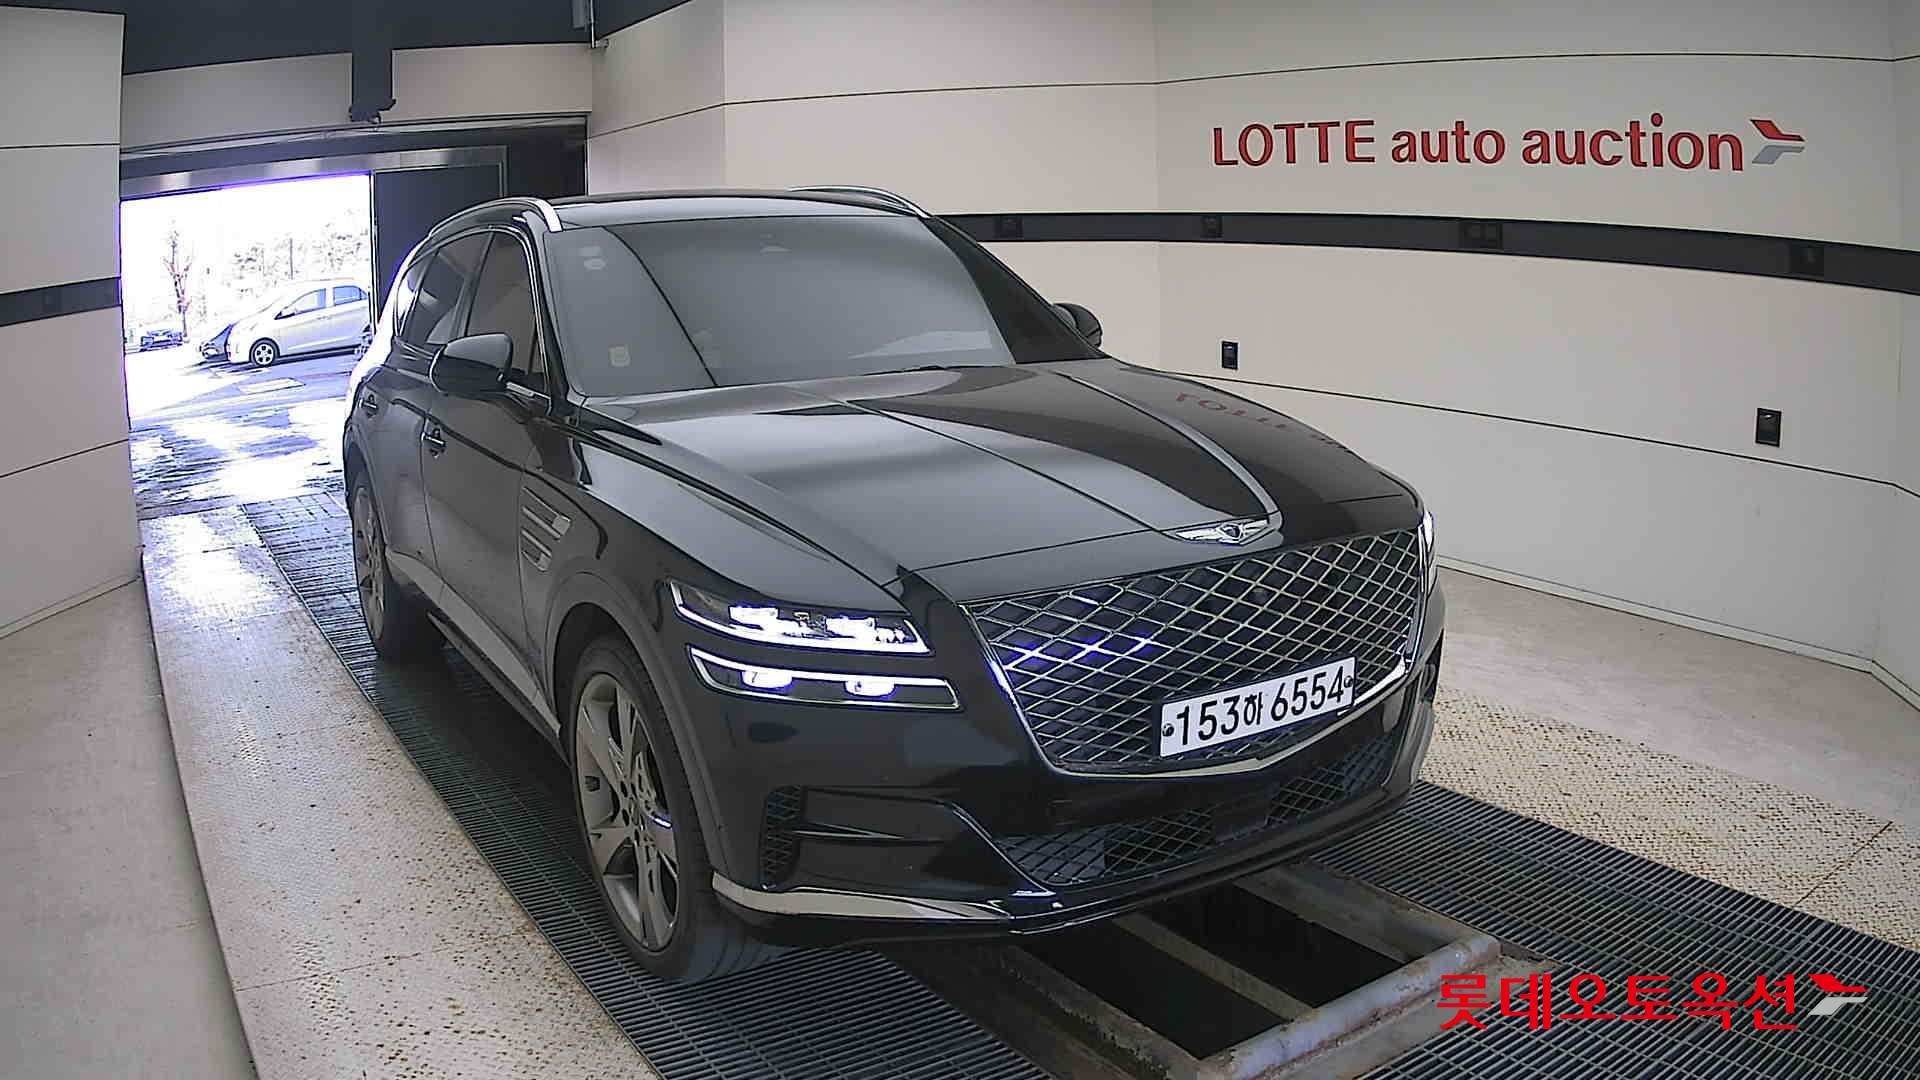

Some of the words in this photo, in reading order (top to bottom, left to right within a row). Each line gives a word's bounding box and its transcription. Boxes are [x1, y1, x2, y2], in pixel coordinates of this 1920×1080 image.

[1213, 120, 1375, 166] LOTTE
[1391, 119, 1506, 164] auto
[1522, 113, 1744, 171] auction
[1176, 692, 1264, 746] 153하
[1270, 666, 1346, 722] 6554
